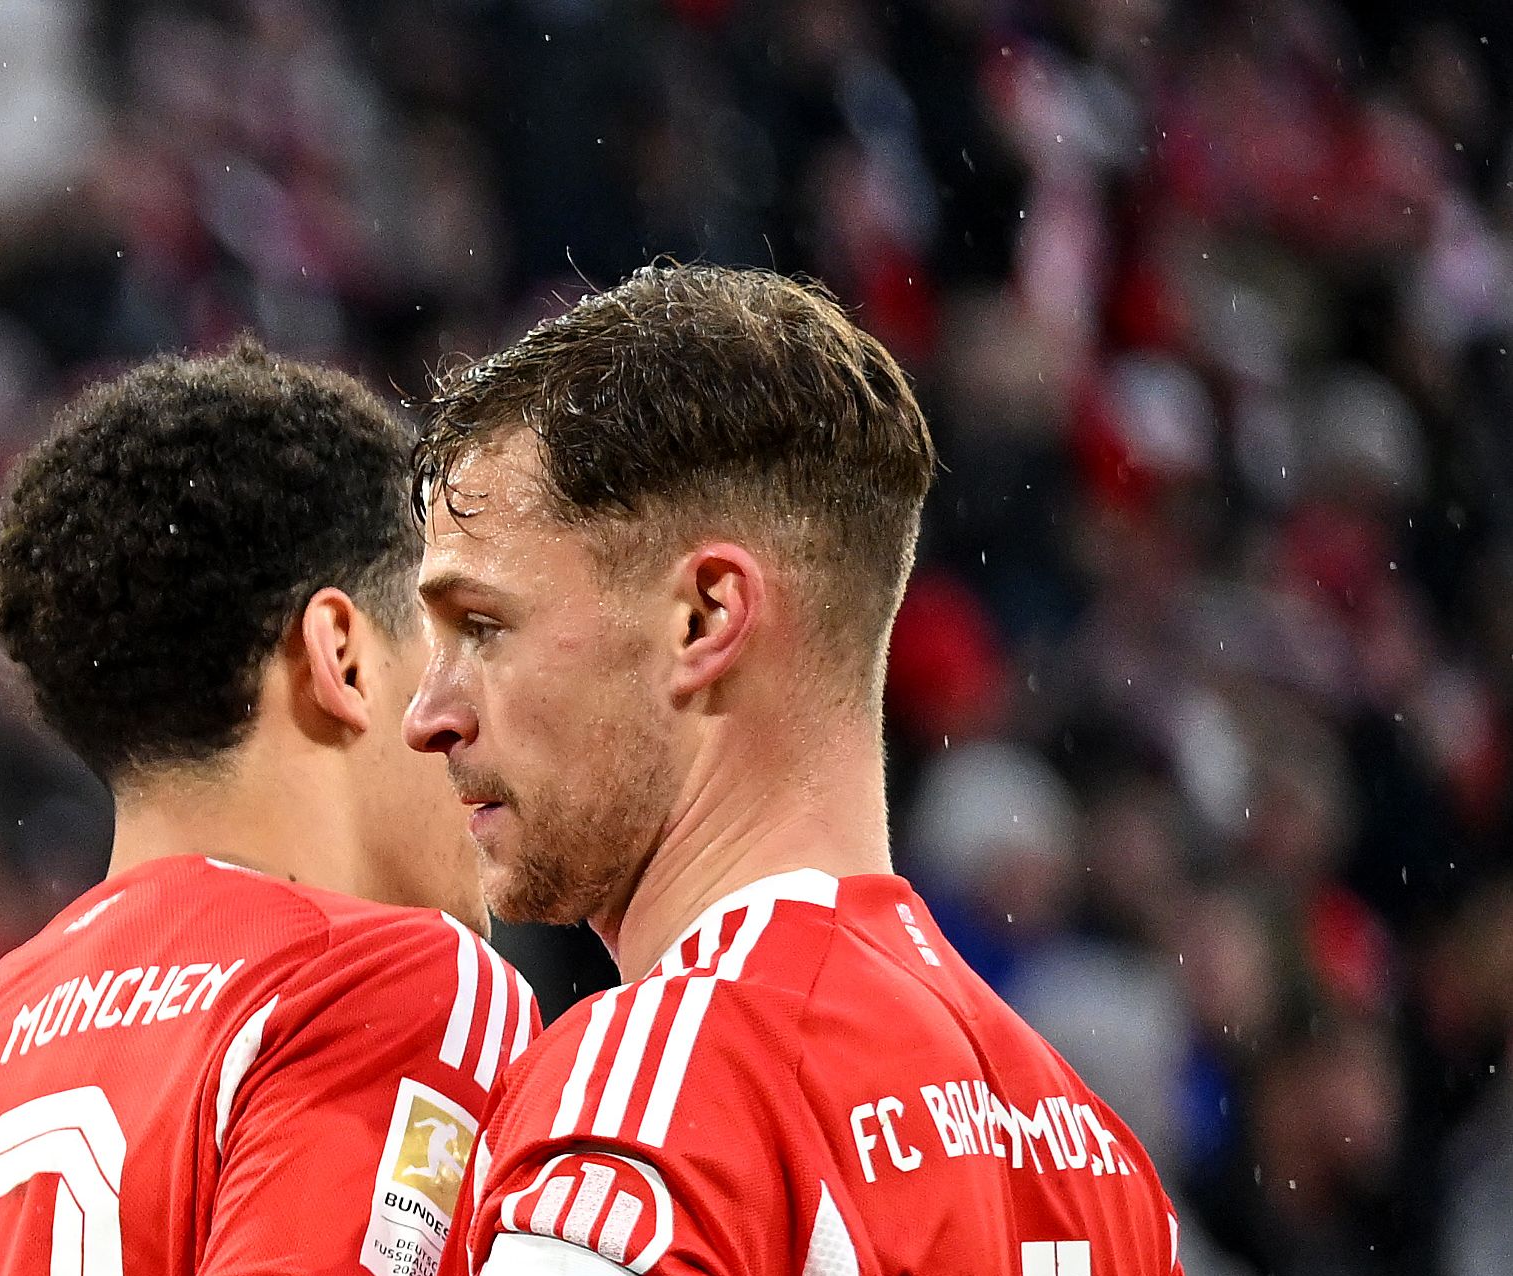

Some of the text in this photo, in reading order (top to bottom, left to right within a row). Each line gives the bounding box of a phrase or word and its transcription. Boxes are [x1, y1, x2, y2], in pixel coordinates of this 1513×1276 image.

[0, 958, 244, 1065] MÜNCHEN
[850, 1096, 923, 1184] FC
[384, 1192, 451, 1242] BUNDES
[396, 1239, 439, 1272] DEUTSC
